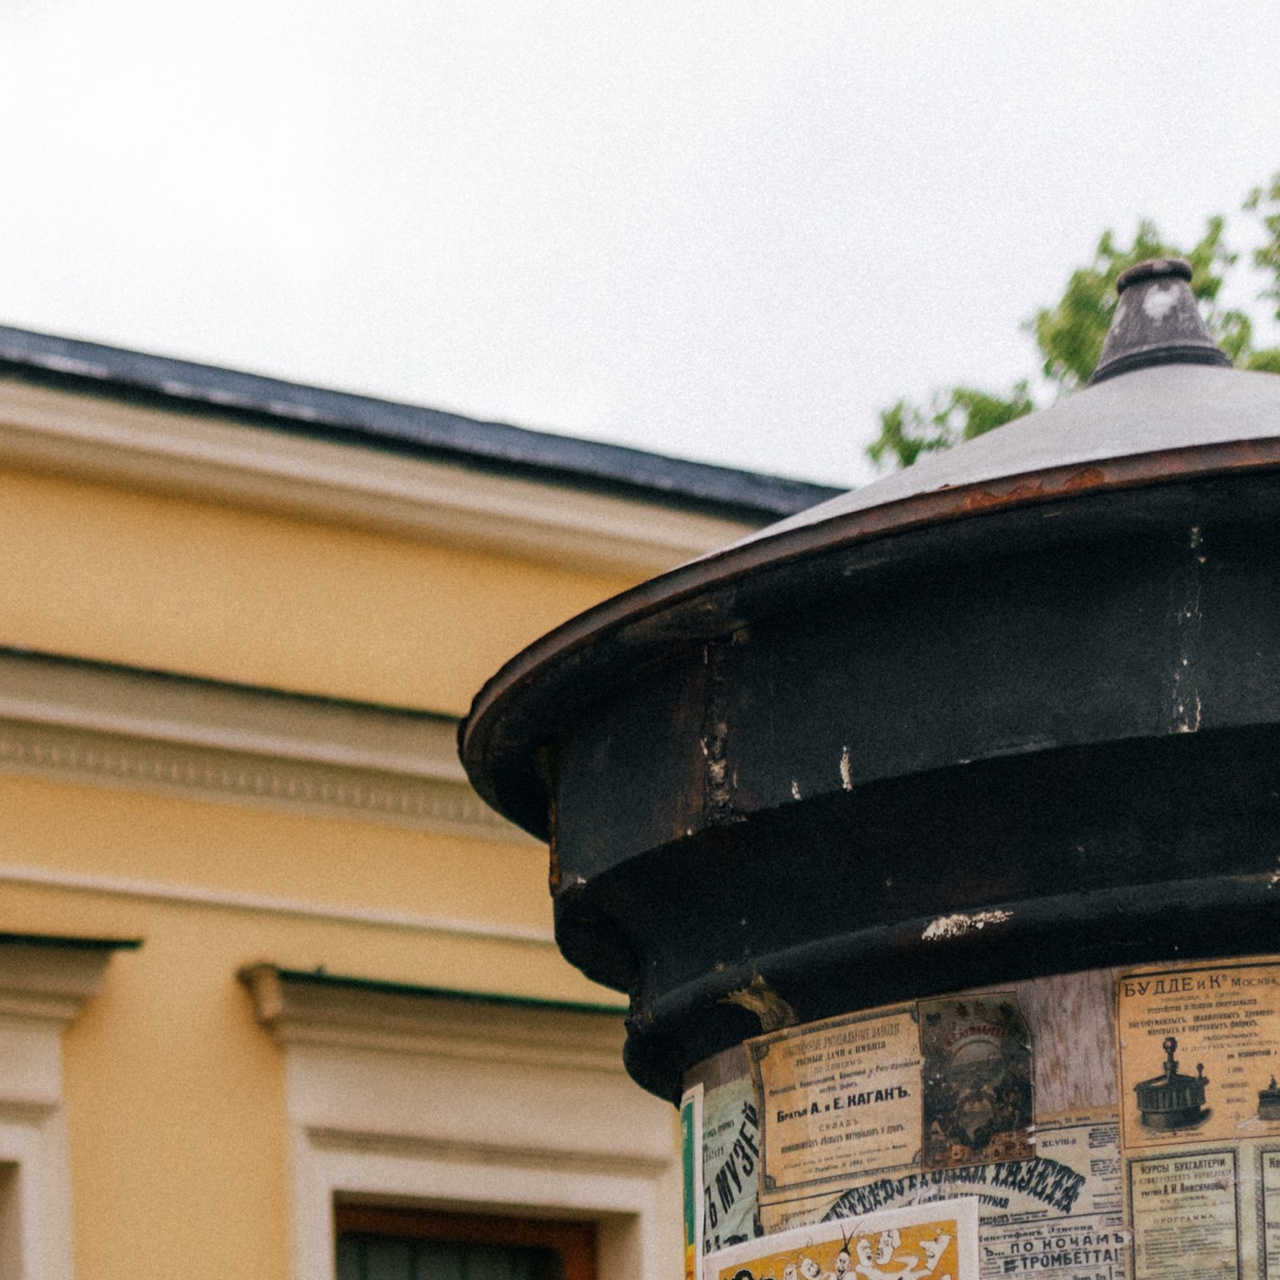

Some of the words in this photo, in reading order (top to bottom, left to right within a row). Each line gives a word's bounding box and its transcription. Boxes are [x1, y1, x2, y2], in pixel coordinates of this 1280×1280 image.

[1124, 977, 1194, 998] БУДДЕ
[1011, 1241, 1034, 1254] ПО
[1043, 1233, 1125, 1250] НОЧАМЪ
